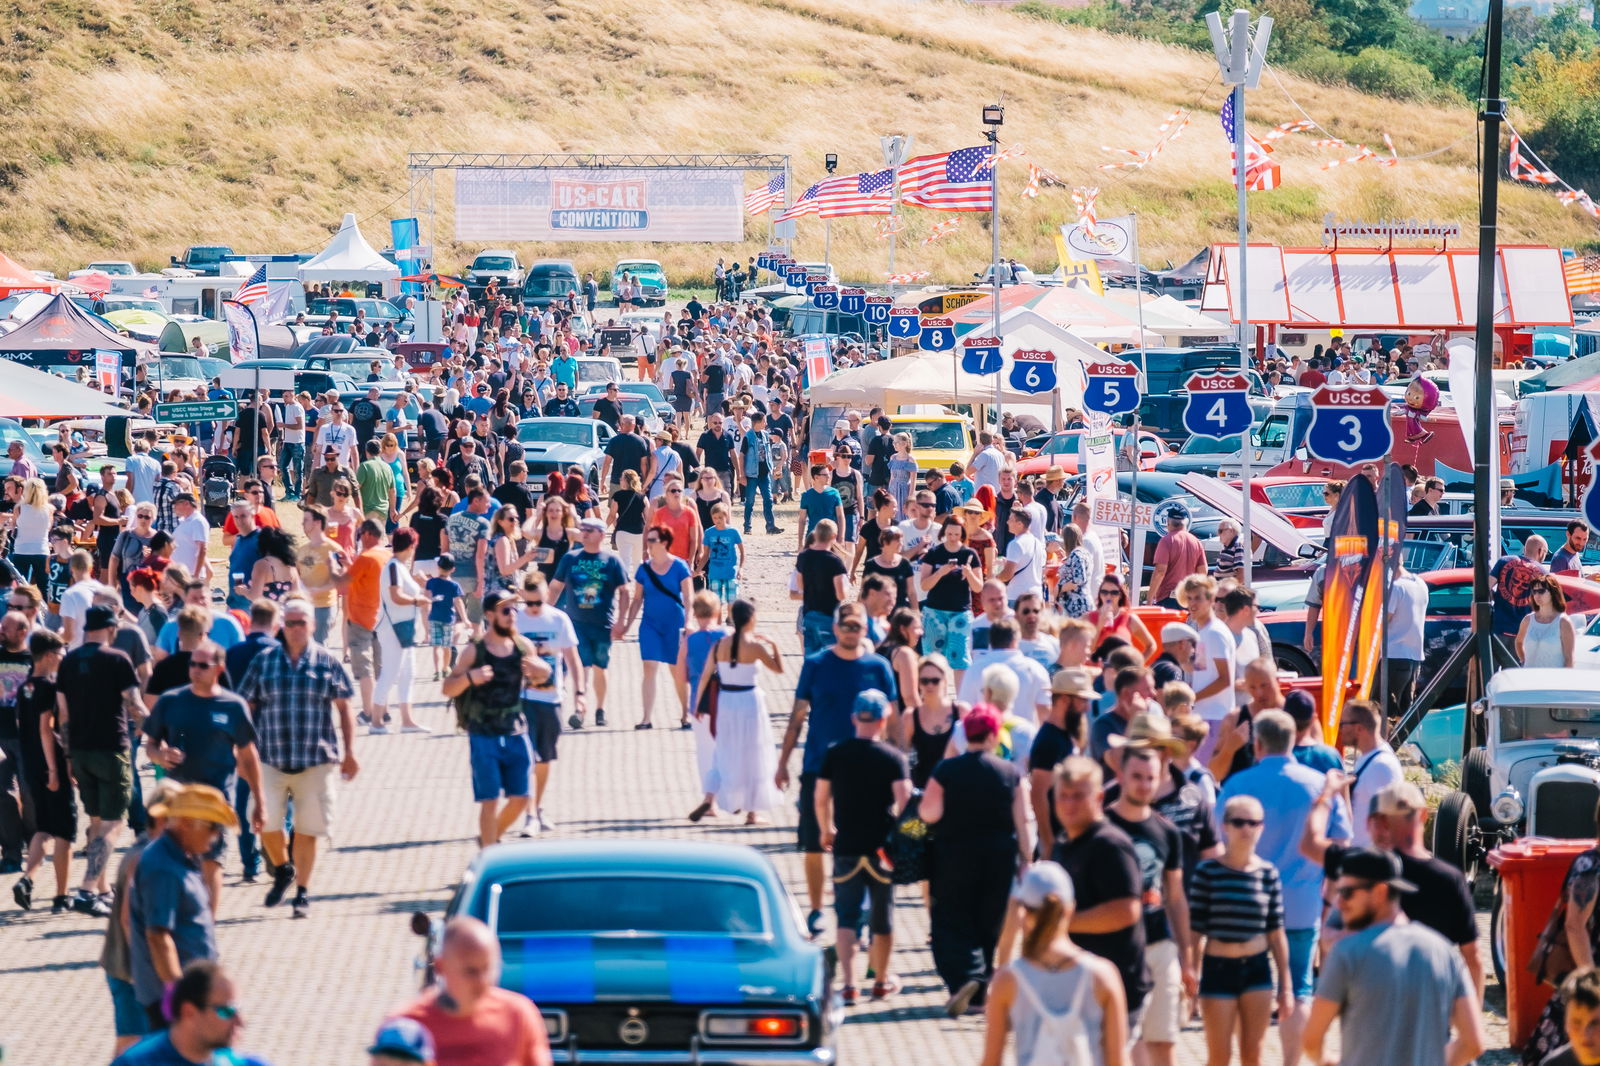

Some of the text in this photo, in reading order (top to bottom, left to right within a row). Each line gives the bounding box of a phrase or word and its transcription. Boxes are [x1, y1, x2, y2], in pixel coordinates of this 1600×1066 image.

[559, 186, 587, 207] US
[596, 186, 639, 208] CAR
[559, 211, 640, 228] CONVENTION
[791, 274, 803, 285] 14
[819, 294, 833, 306] 12
[848, 297, 858, 311] 11
[871, 306, 887, 320] 10
[899, 318, 910, 334] 9
[931, 330, 944, 347] 8
[0, 352, 33, 361] 4MX
[975, 350, 989, 370] 7
[1021, 352, 1047, 360] USCC
[1025, 365, 1041, 387] 6
[1097, 366, 1127, 374] USCC
[1200, 379, 1236, 389] USCC
[1103, 381, 1120, 407] 5
[1328, 392, 1371, 404] USCC
[1205, 397, 1228, 428] 4
[1337, 415, 1363, 452] 3
[1096, 501, 1152, 515] SERVCE
